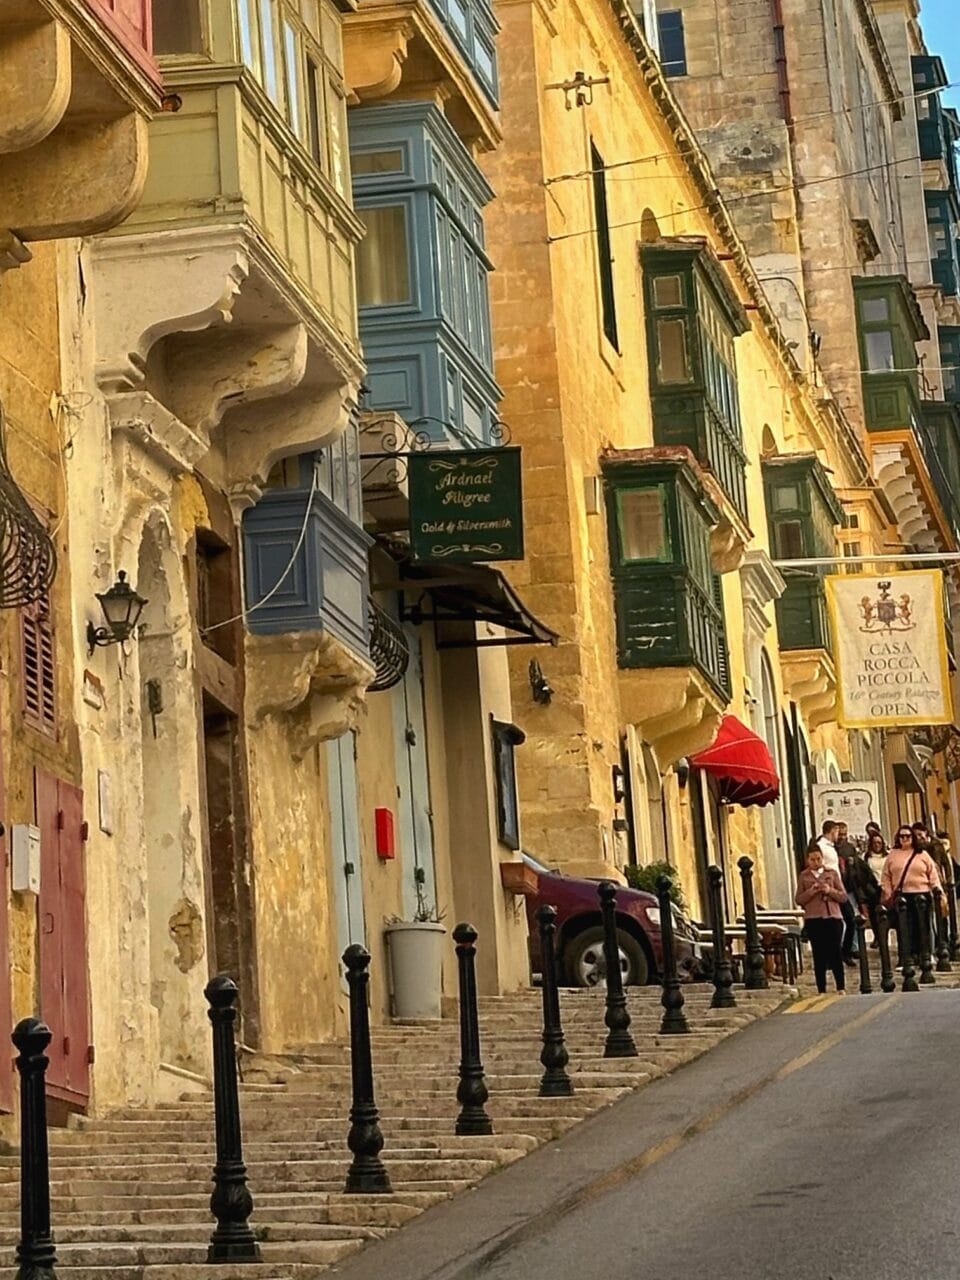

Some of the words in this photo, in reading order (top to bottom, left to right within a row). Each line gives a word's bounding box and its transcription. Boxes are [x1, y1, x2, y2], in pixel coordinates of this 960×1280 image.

[421, 521, 444, 533] Gold
[869, 641, 912, 656] CASA
[863, 656, 921, 672] ROCCA
[857, 671, 930, 687] PICCOLA
[870, 703, 919, 717] OPEN
